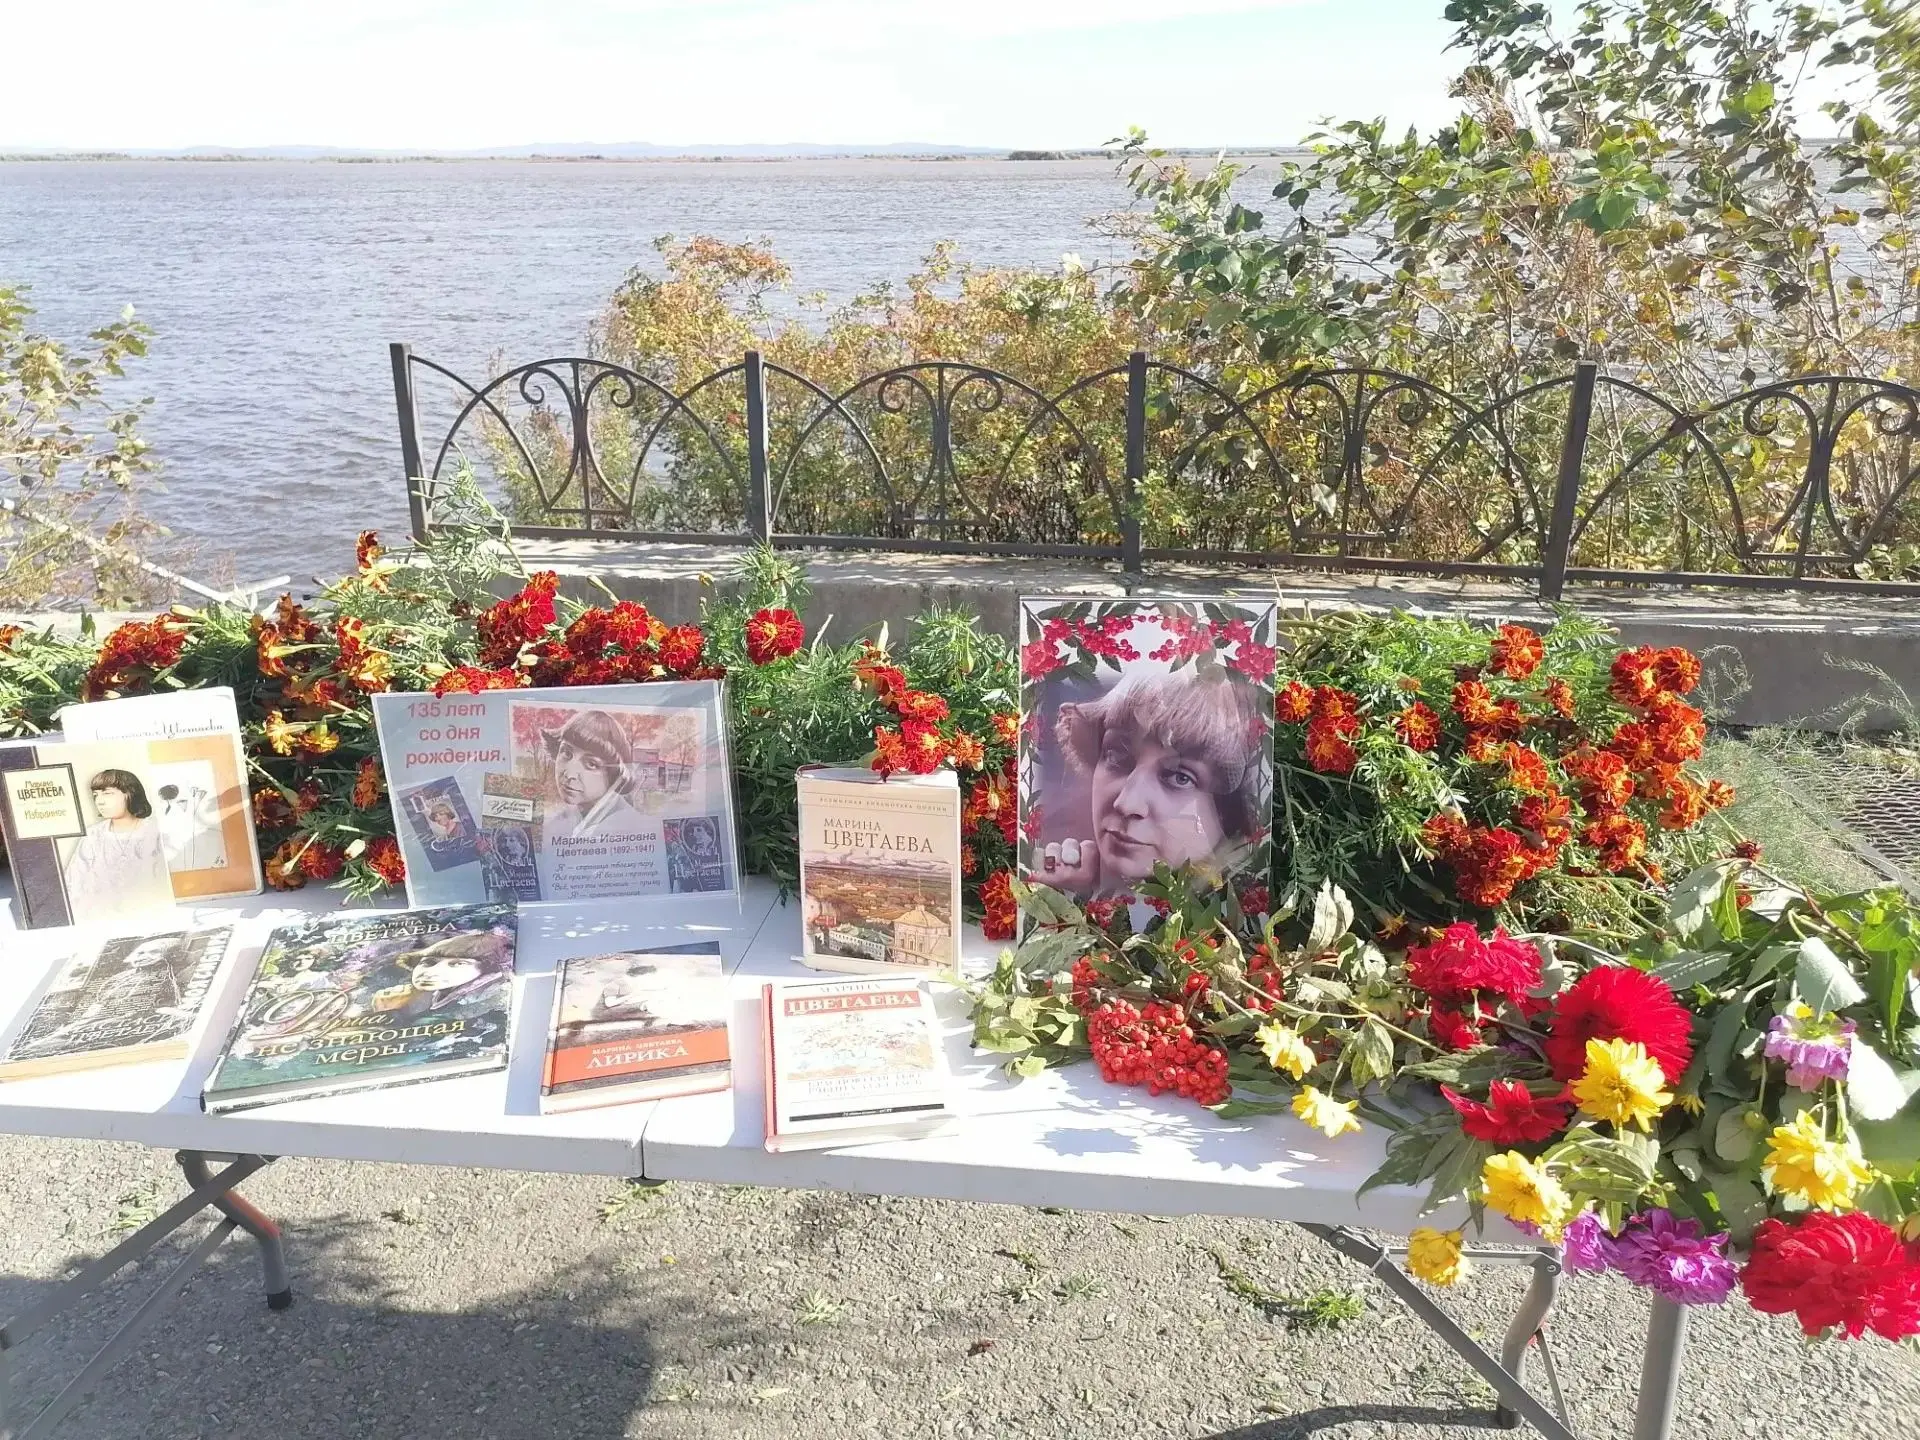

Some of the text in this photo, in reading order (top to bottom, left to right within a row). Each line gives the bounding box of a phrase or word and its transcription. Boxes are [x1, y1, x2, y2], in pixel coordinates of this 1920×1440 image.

[408, 702, 486, 718] 135 лет
[419, 724, 481, 741] со дня
[406, 748, 506, 769] рождения.
[17, 785, 66, 801] ЦВЕТАЕВА
[824, 817, 882, 832] МАРИНА
[551, 832, 657, 848] Марина Ивановна
[823, 829, 933, 853] ЦВЕТАЕВА
[556, 847, 607, 858] Цветаева
[330, 922, 457, 944] ЦВЕТАЕВА
[788, 993, 915, 1016] ЦВЕТАЕВА
[255, 1019, 466, 1058] не знающая
[315, 1042, 427, 1065] меры...
[586, 1045, 689, 1070] ЛИРИКА
